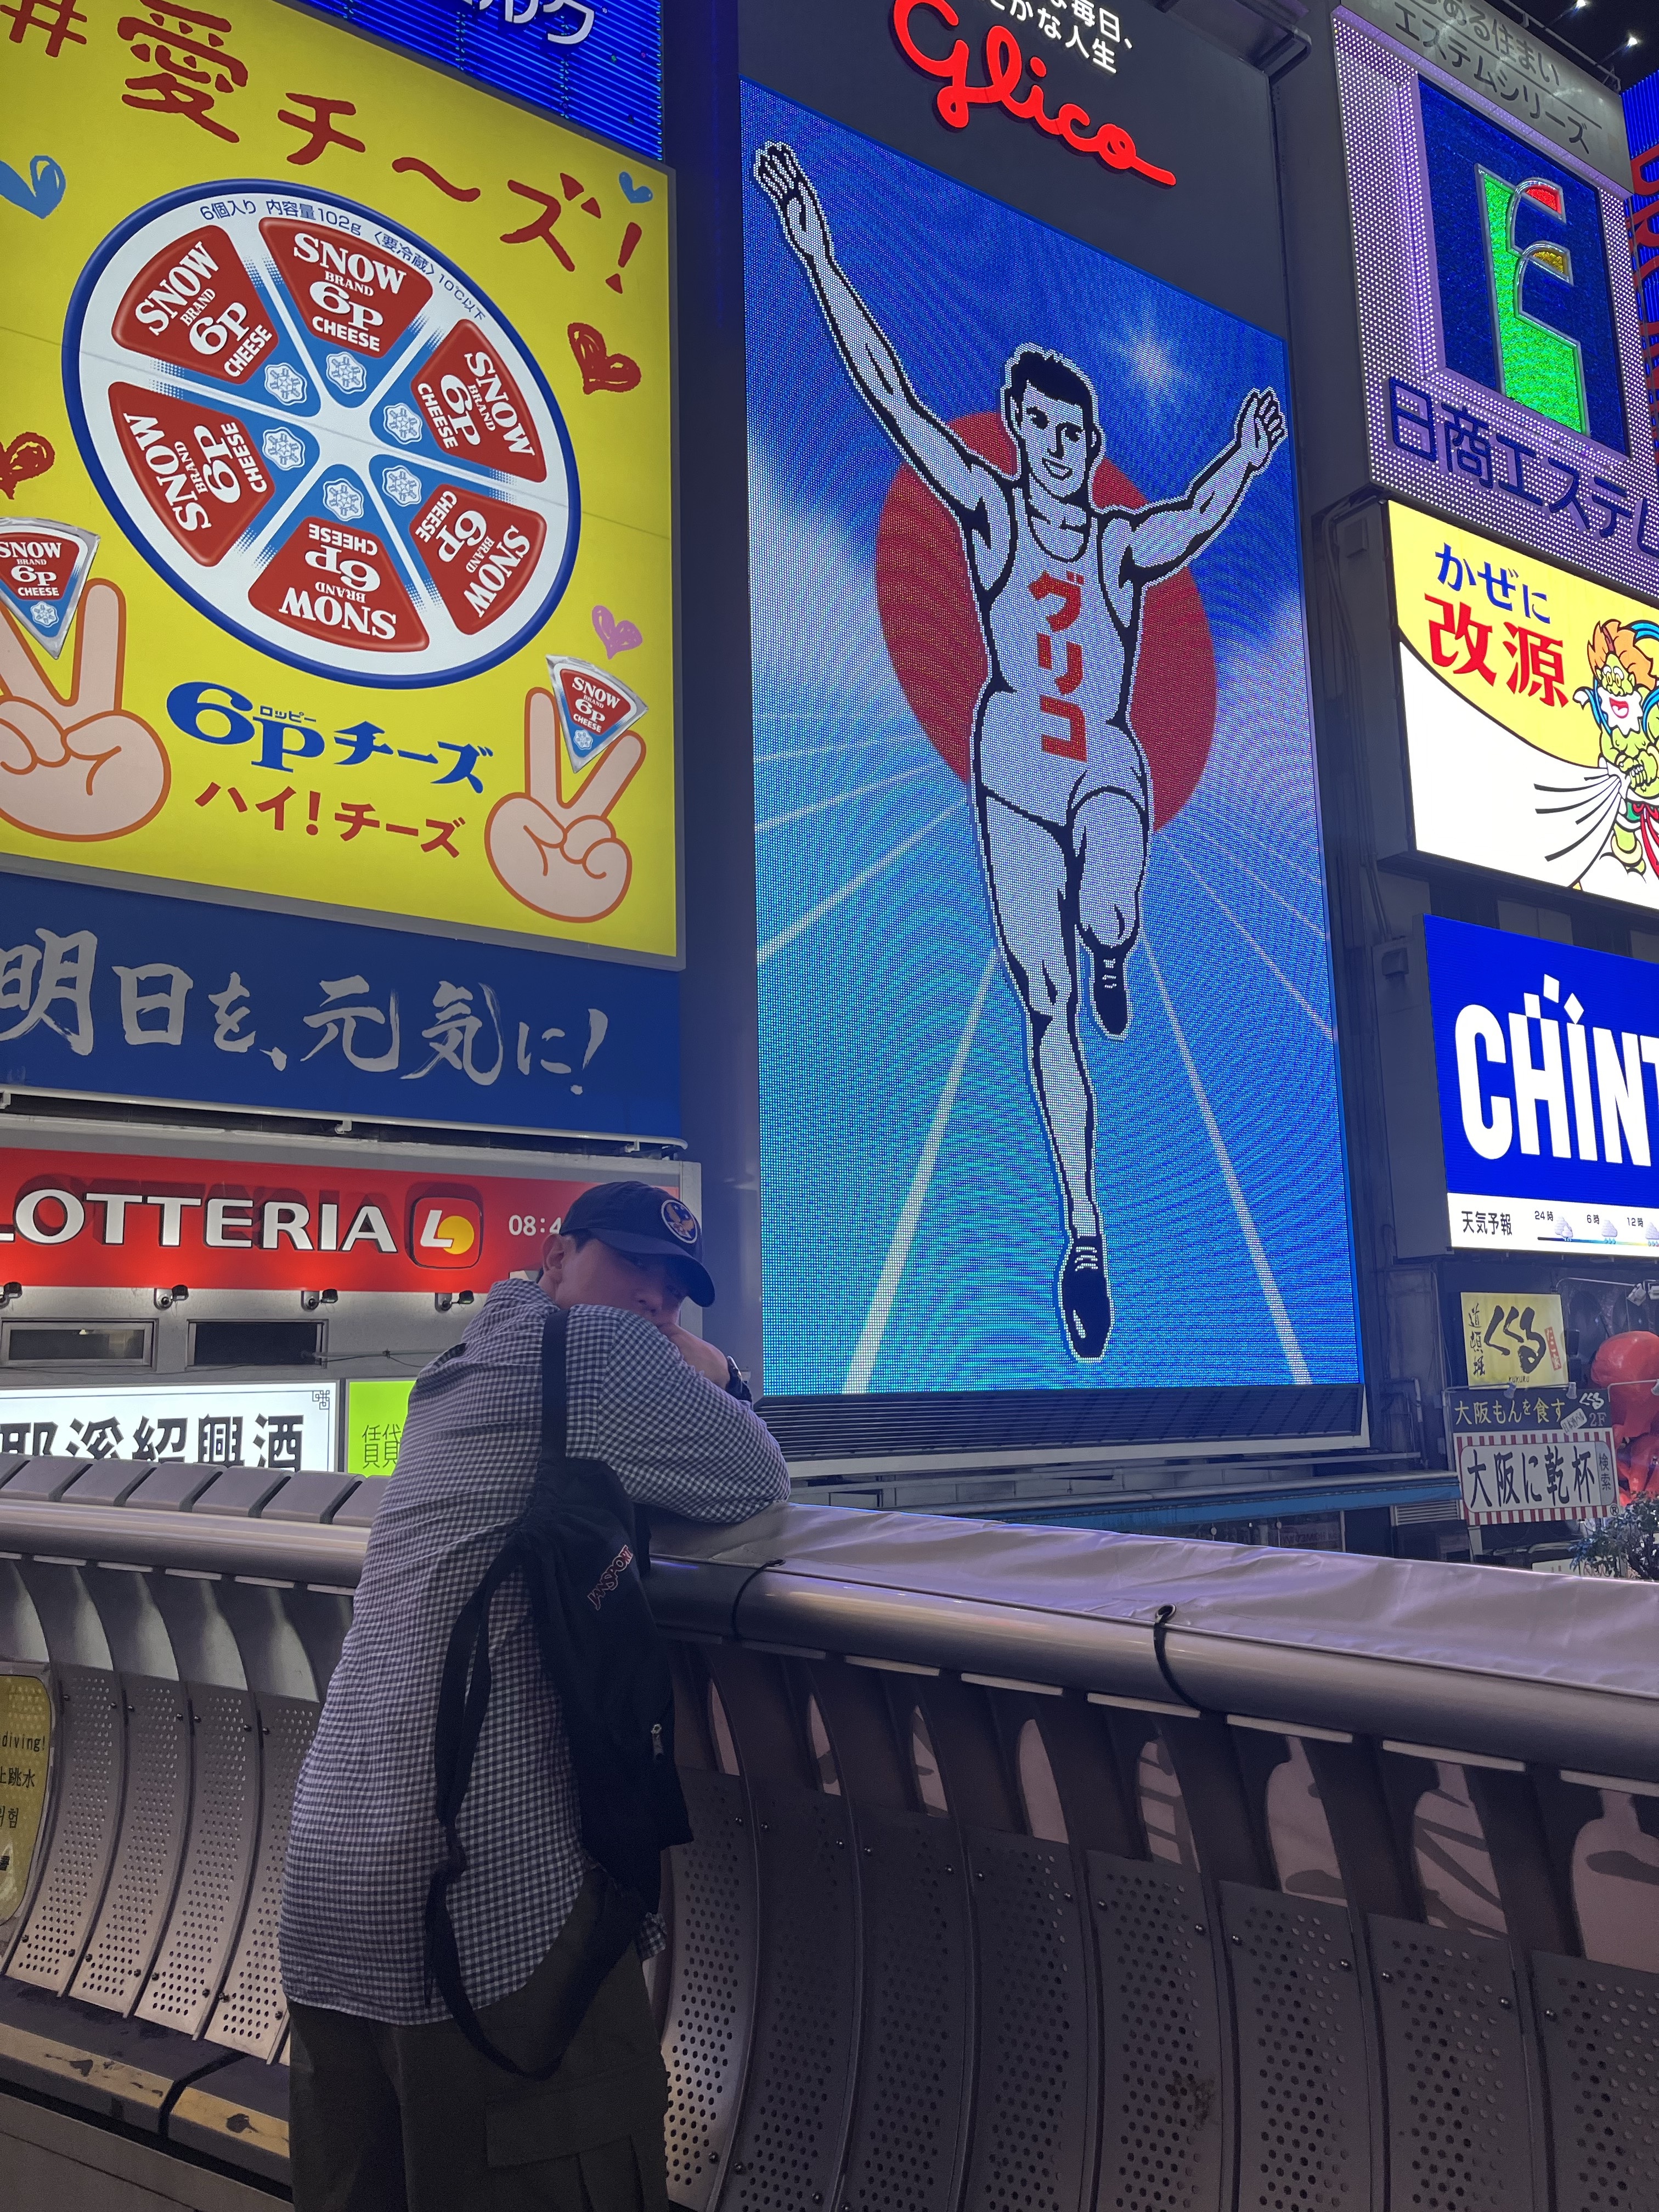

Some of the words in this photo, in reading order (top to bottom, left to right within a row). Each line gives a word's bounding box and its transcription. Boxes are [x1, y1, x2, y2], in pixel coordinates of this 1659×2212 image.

[990, 0, 1117, 74] かな人生
[894, 0, 1176, 185] Glico
[1395, 2, 1589, 154] エステムシリーズ
[200, 199, 257, 221] 6個入り
[266, 199, 362, 236] 内容量102g
[135, 241, 219, 336] SNOW
[294, 233, 407, 294] SNOW
[324, 271, 374, 296] BRAND
[180, 287, 216, 327] BRAND
[189, 302, 250, 356] 6P
[309, 281, 383, 330] 6P
[223, 325, 273, 377] CHEESE
[312, 315, 381, 352] CHEESE
[417, 383, 459, 448] CHEESE
[440, 374, 481, 445] 6P
[464, 352, 535, 456] SNOW
[467, 383, 496, 431] BRAND
[123, 413, 212, 531] SNOW
[174, 441, 208, 494] BRAND
[194, 425, 240, 503] 6P
[220, 422, 268, 493] CHEESE
[308, 524, 377, 556] CHEESE
[415, 491, 457, 541] CHEESE
[438, 510, 487, 562] 6P
[0, 541, 62, 558] SNOW
[304, 545, 380, 592] 6P
[464, 525, 530, 618] SNOW
[466, 535, 495, 573] BRAND
[18, 587, 59, 596] CHEESE
[315, 581, 365, 603] BRAND
[1435, 542, 1550, 624] かぜに
[279, 587, 397, 640] SNOW
[1028, 571, 1087, 763] グリコ
[1424, 592, 1569, 708] 改源
[572, 677, 620, 709] SNOW
[583, 695, 604, 708] BRAND
[573, 714, 601, 732] CHEESE
[509, 1215, 561, 1236] 08:4
[1461, 1210, 1513, 1236] 天気予報
[1454, 1397, 1565, 1426] 大阪もんを食す
[1589, 1412, 1607, 1427] 2F
[1467, 1445, 1595, 1508] 大阪に乾杯
[1599, 1452, 1612, 1492] 検索
